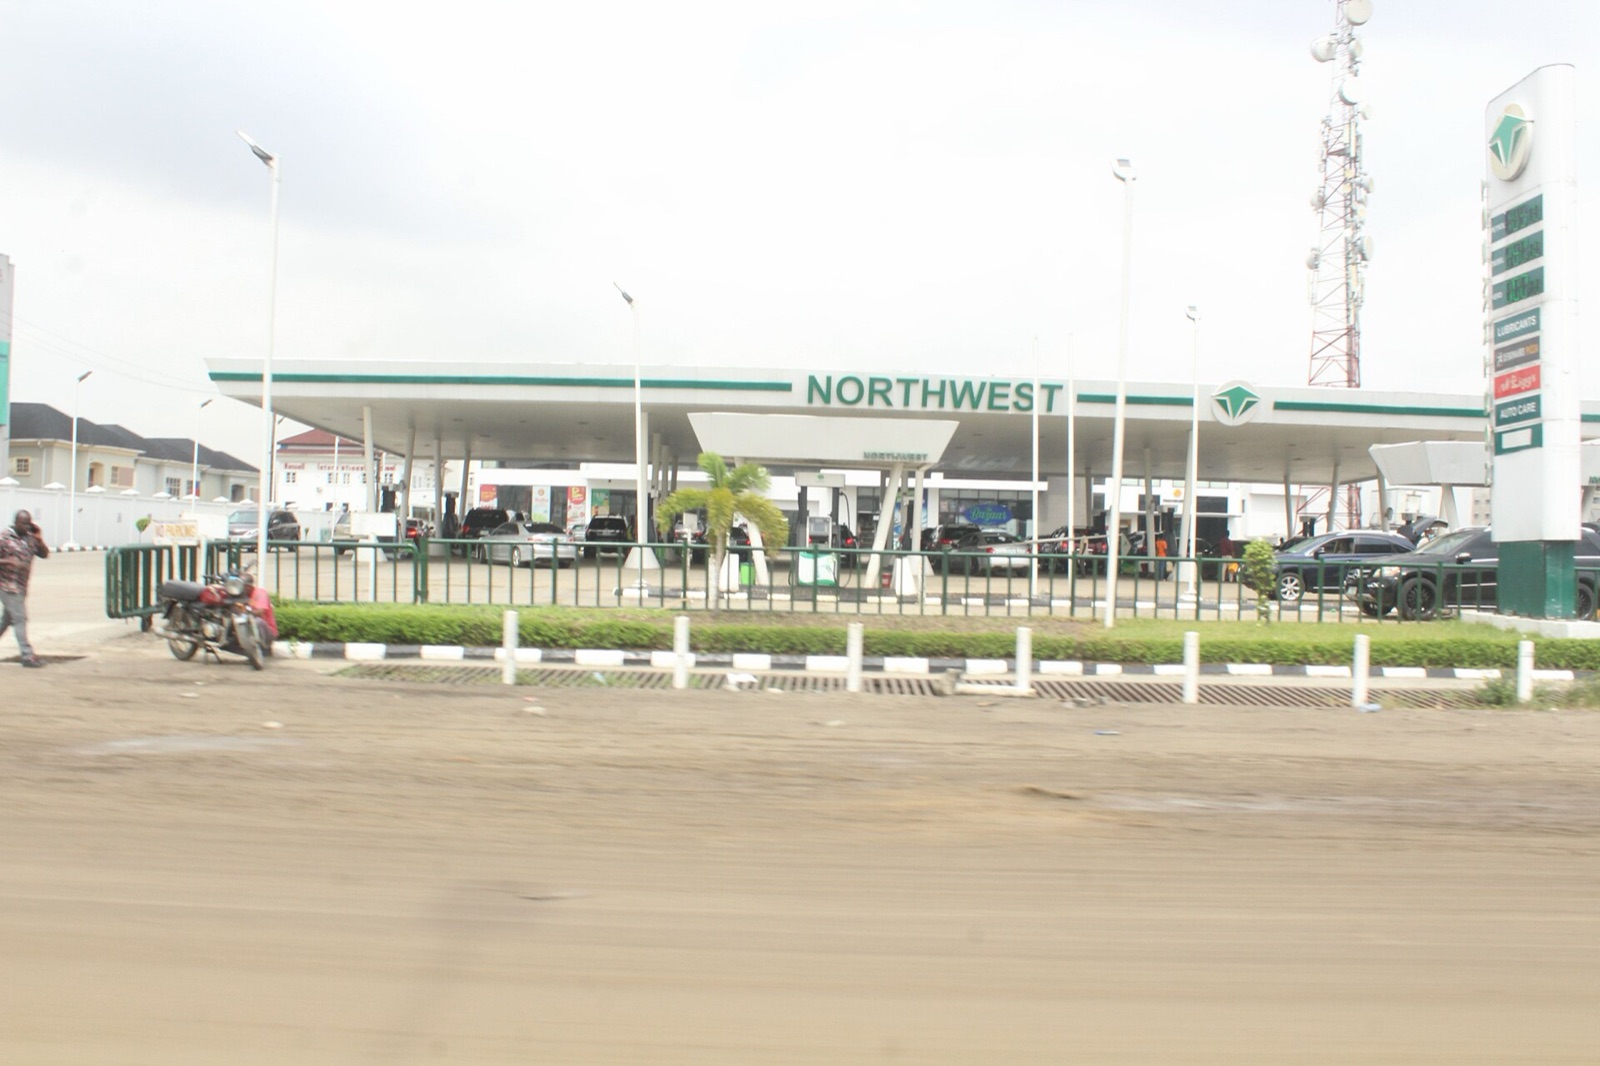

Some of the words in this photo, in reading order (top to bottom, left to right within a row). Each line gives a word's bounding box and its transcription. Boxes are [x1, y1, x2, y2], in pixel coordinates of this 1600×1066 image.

[1497, 315, 1537, 337] LUBRICANTS
[807, 375, 1064, 412] NORTHWEST
[1500, 405, 1517, 419] AUTO
[1517, 401, 1537, 416] CARE
[864, 451, 929, 461] NORTHWEST
